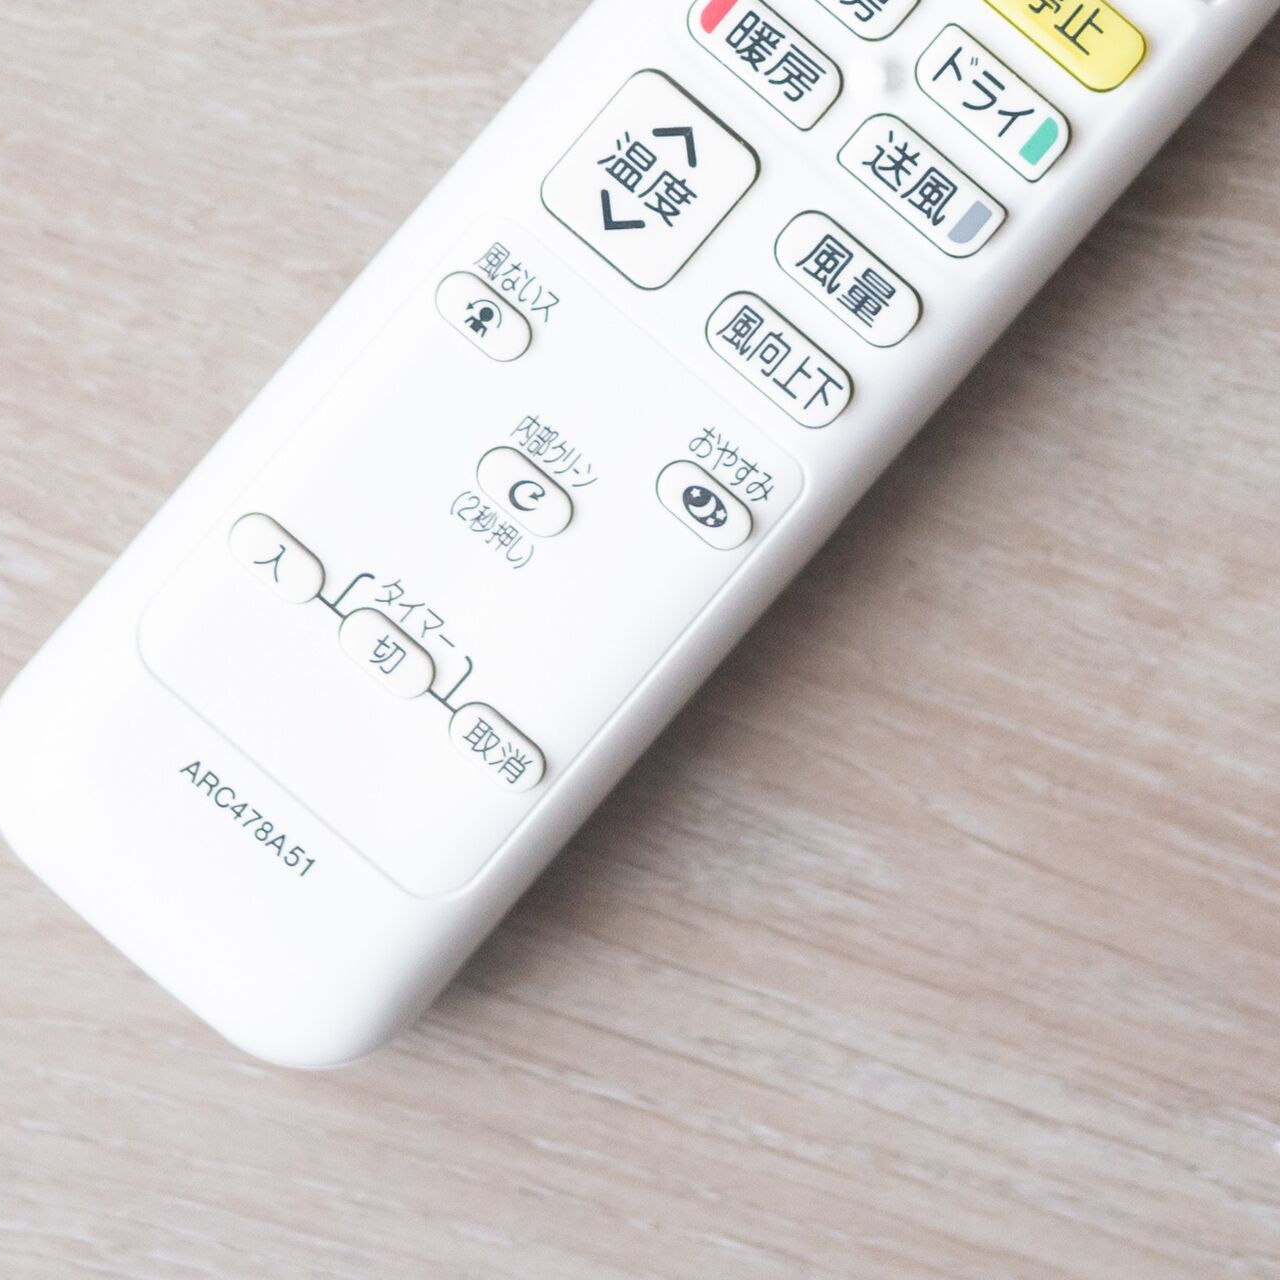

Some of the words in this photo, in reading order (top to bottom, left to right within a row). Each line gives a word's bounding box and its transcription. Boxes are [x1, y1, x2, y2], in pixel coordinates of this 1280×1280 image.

[724, 10, 827, 103] 暖房
[931, 46, 1035, 138] ドライ
[596, 131, 699, 228] 温度
[861, 130, 959, 226] 送風
[473, 241, 561, 323] 風ないス
[795, 233, 897, 329] 風量
[715, 304, 844, 410] 風向上下
[510, 414, 599, 488] 内部クリーン
[688, 426, 775, 503] おやすみ
[253, 544, 287, 584] 入
[449, 490, 535, 570] (2秒押し)
[369, 634, 407, 675] 切
[374, 579, 455, 649] タイマー
[462, 717, 534, 785] 取消
[179, 760, 317, 878] ARC478A51
